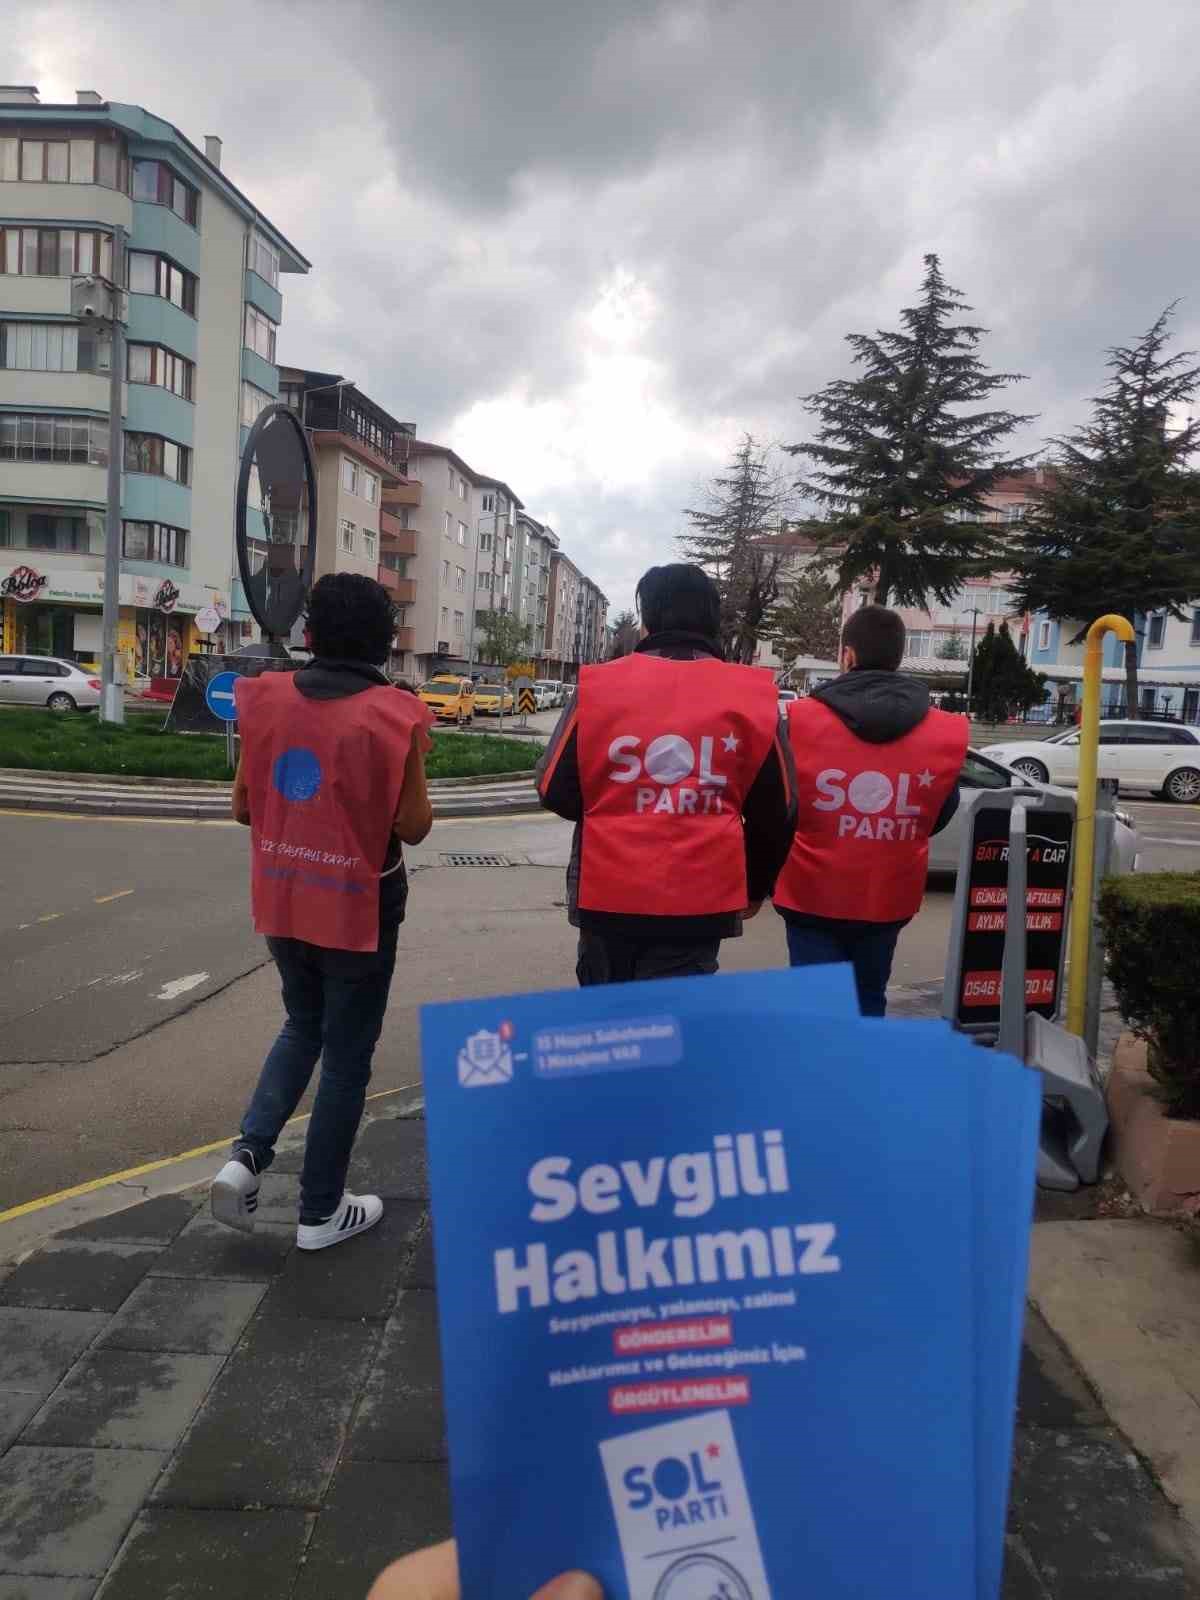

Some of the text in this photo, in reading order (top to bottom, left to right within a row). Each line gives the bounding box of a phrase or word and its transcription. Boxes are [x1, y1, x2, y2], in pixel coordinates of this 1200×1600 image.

[608, 734, 727, 785] SOL
[813, 768, 920, 815] SOL
[975, 847, 998, 861] BAY
[1042, 848, 1066, 863] CAR
[1025, 892, 1061, 904] AFTALIK
[964, 980, 997, 996] 0546
[528, 1129, 789, 1222] Sevgili
[494, 1223, 841, 1314] Halkımız
[644, 1358, 664, 1372] ve
[623, 1451, 721, 1510] SOL
